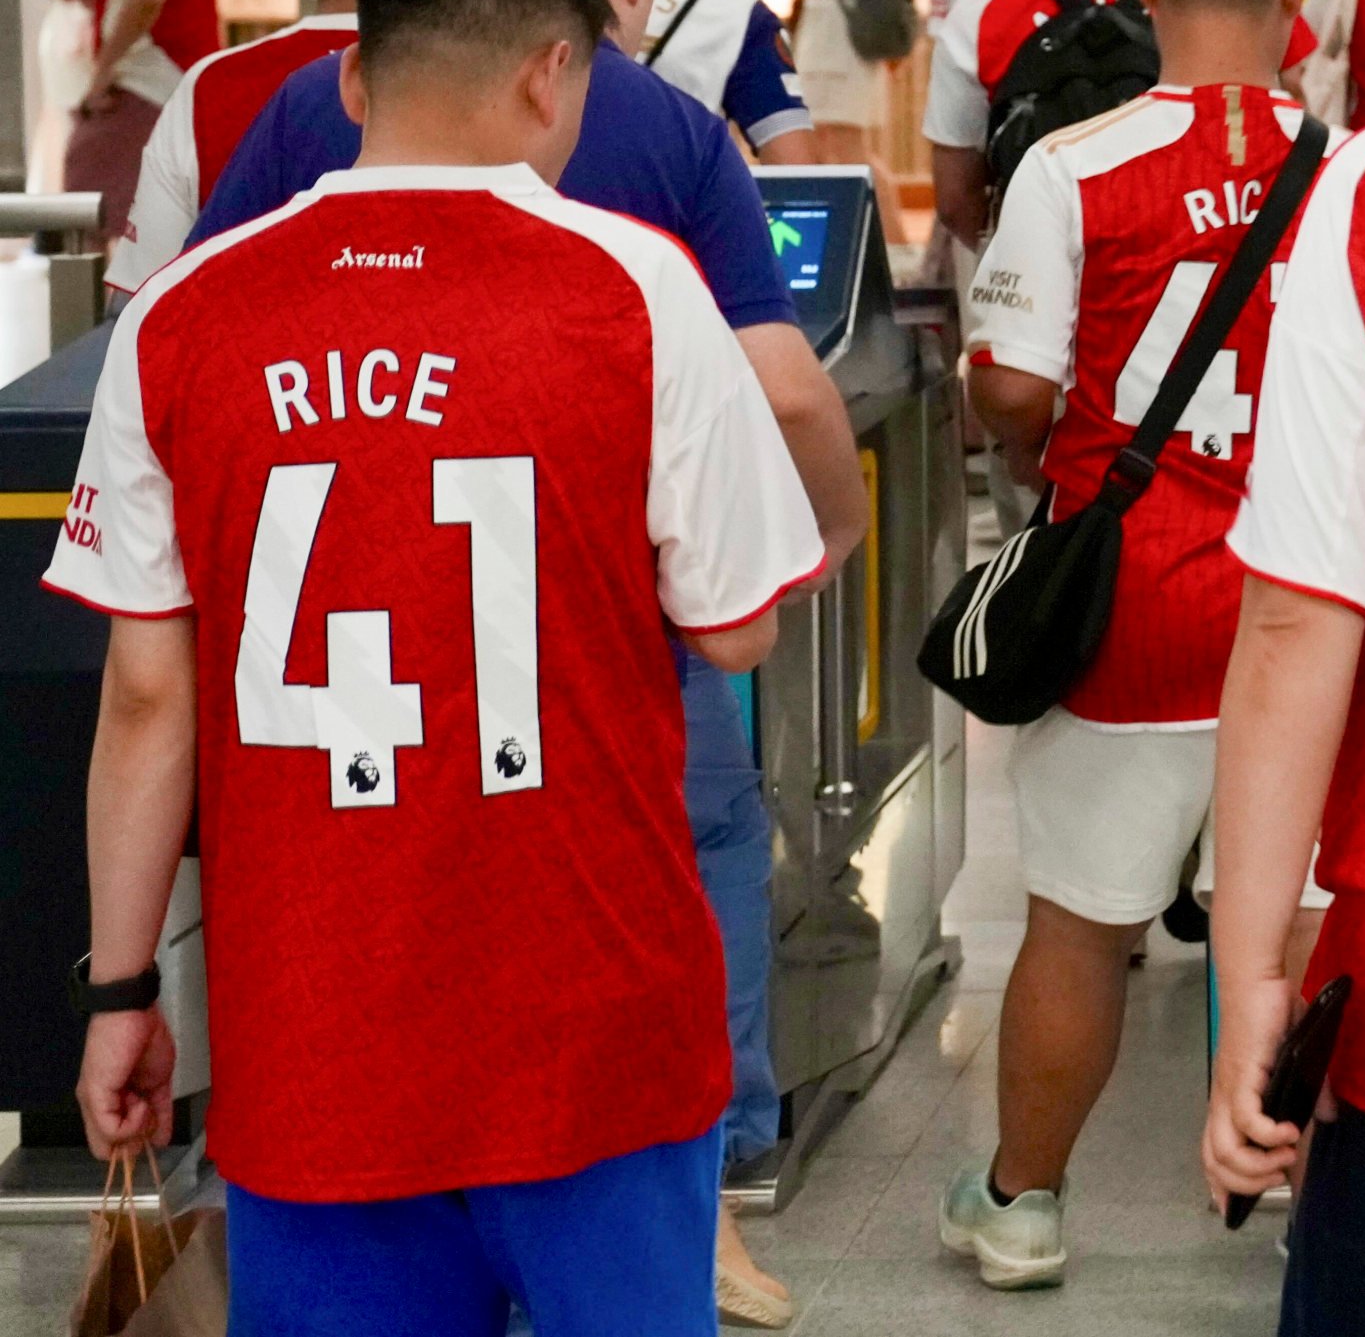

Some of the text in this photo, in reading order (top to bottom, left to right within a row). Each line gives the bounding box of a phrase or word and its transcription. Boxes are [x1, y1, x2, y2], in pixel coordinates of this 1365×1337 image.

[1183, 178, 1263, 235] RIC
[330, 245, 426, 271] Arsenal
[263, 347, 457, 435] RICE
[1113, 259, 1289, 461] 4
[233, 455, 544, 811] 41
